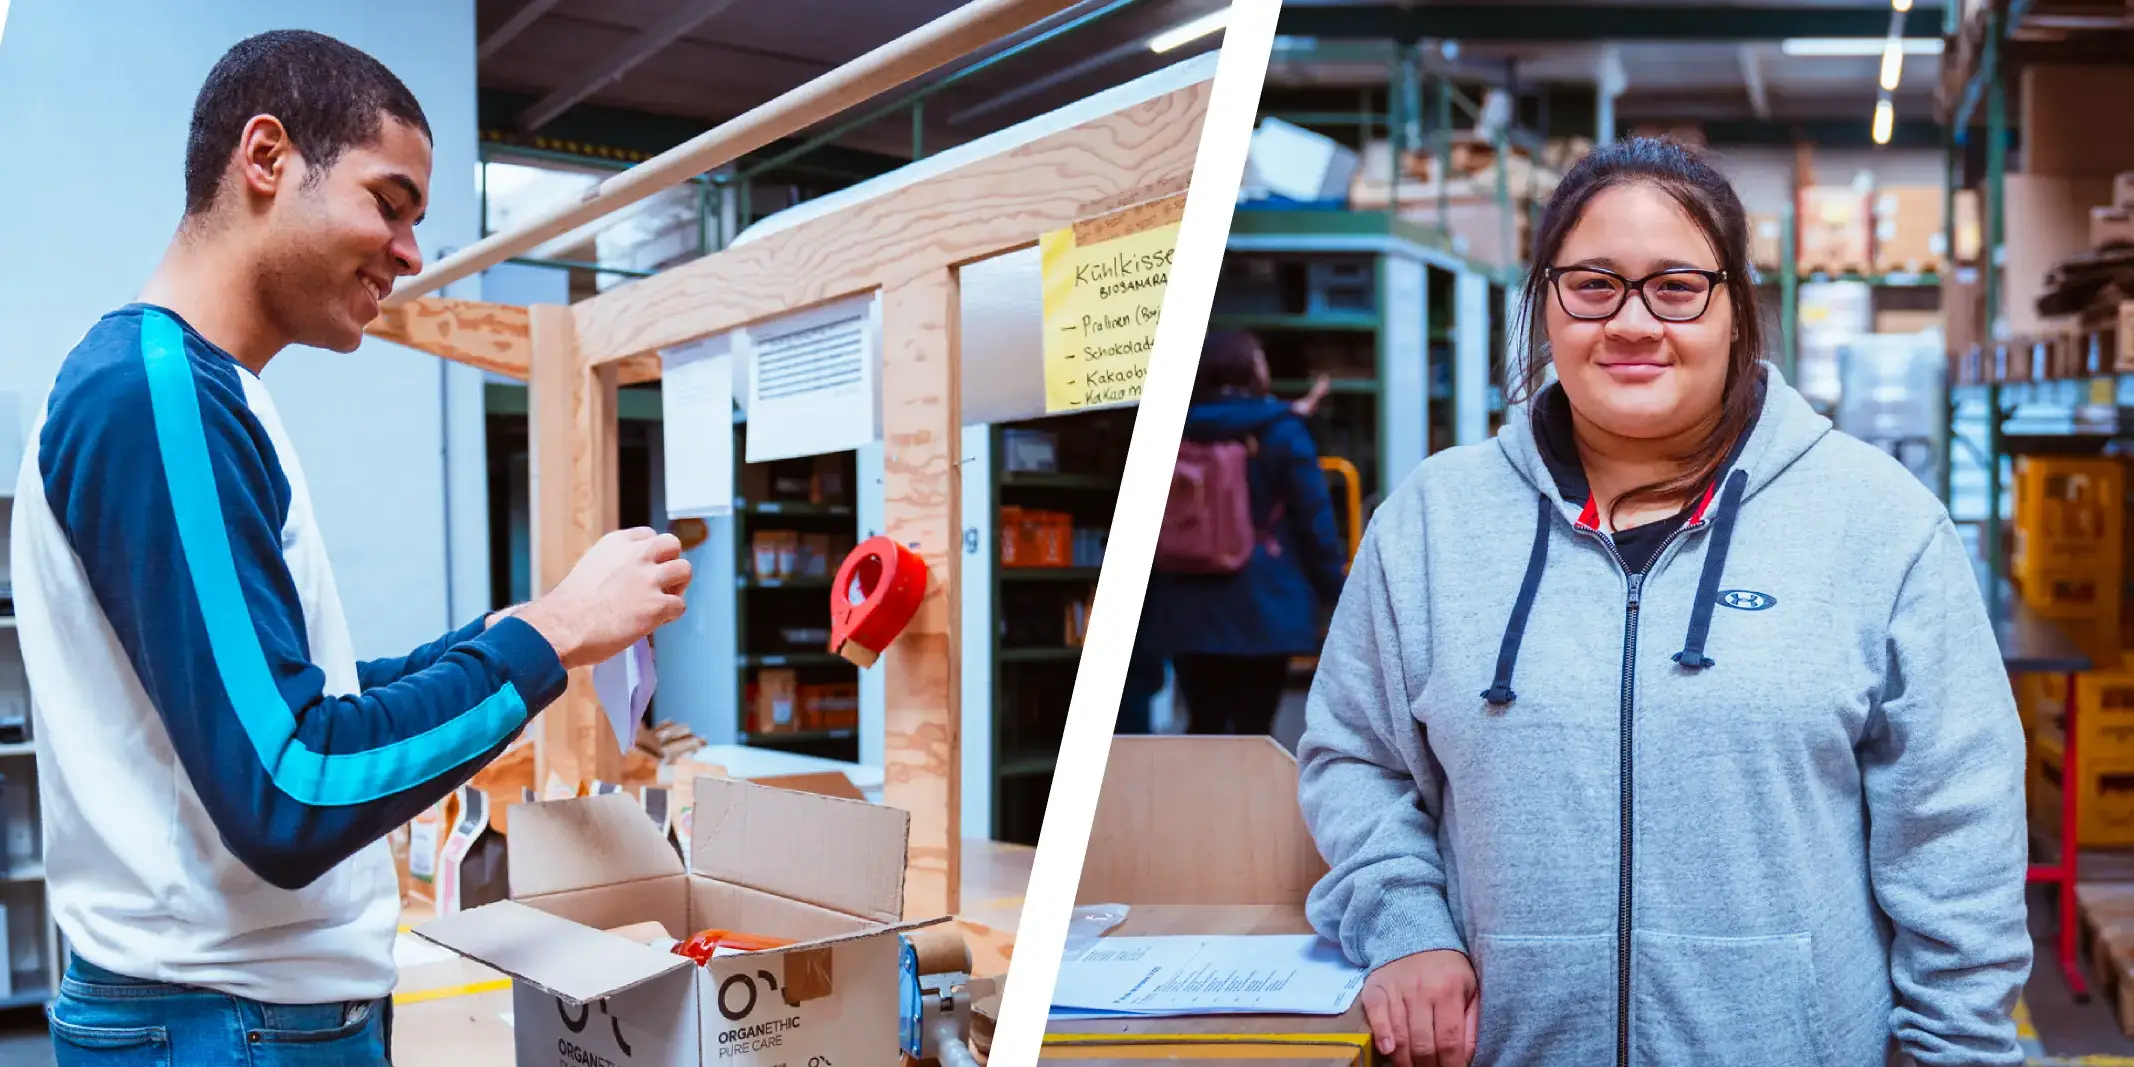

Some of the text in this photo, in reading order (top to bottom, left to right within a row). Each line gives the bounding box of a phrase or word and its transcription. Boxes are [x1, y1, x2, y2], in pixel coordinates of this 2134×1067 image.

[718, 1016, 801, 1045] ORGANETHIC
[719, 1035, 783, 1059] PURE CARE
